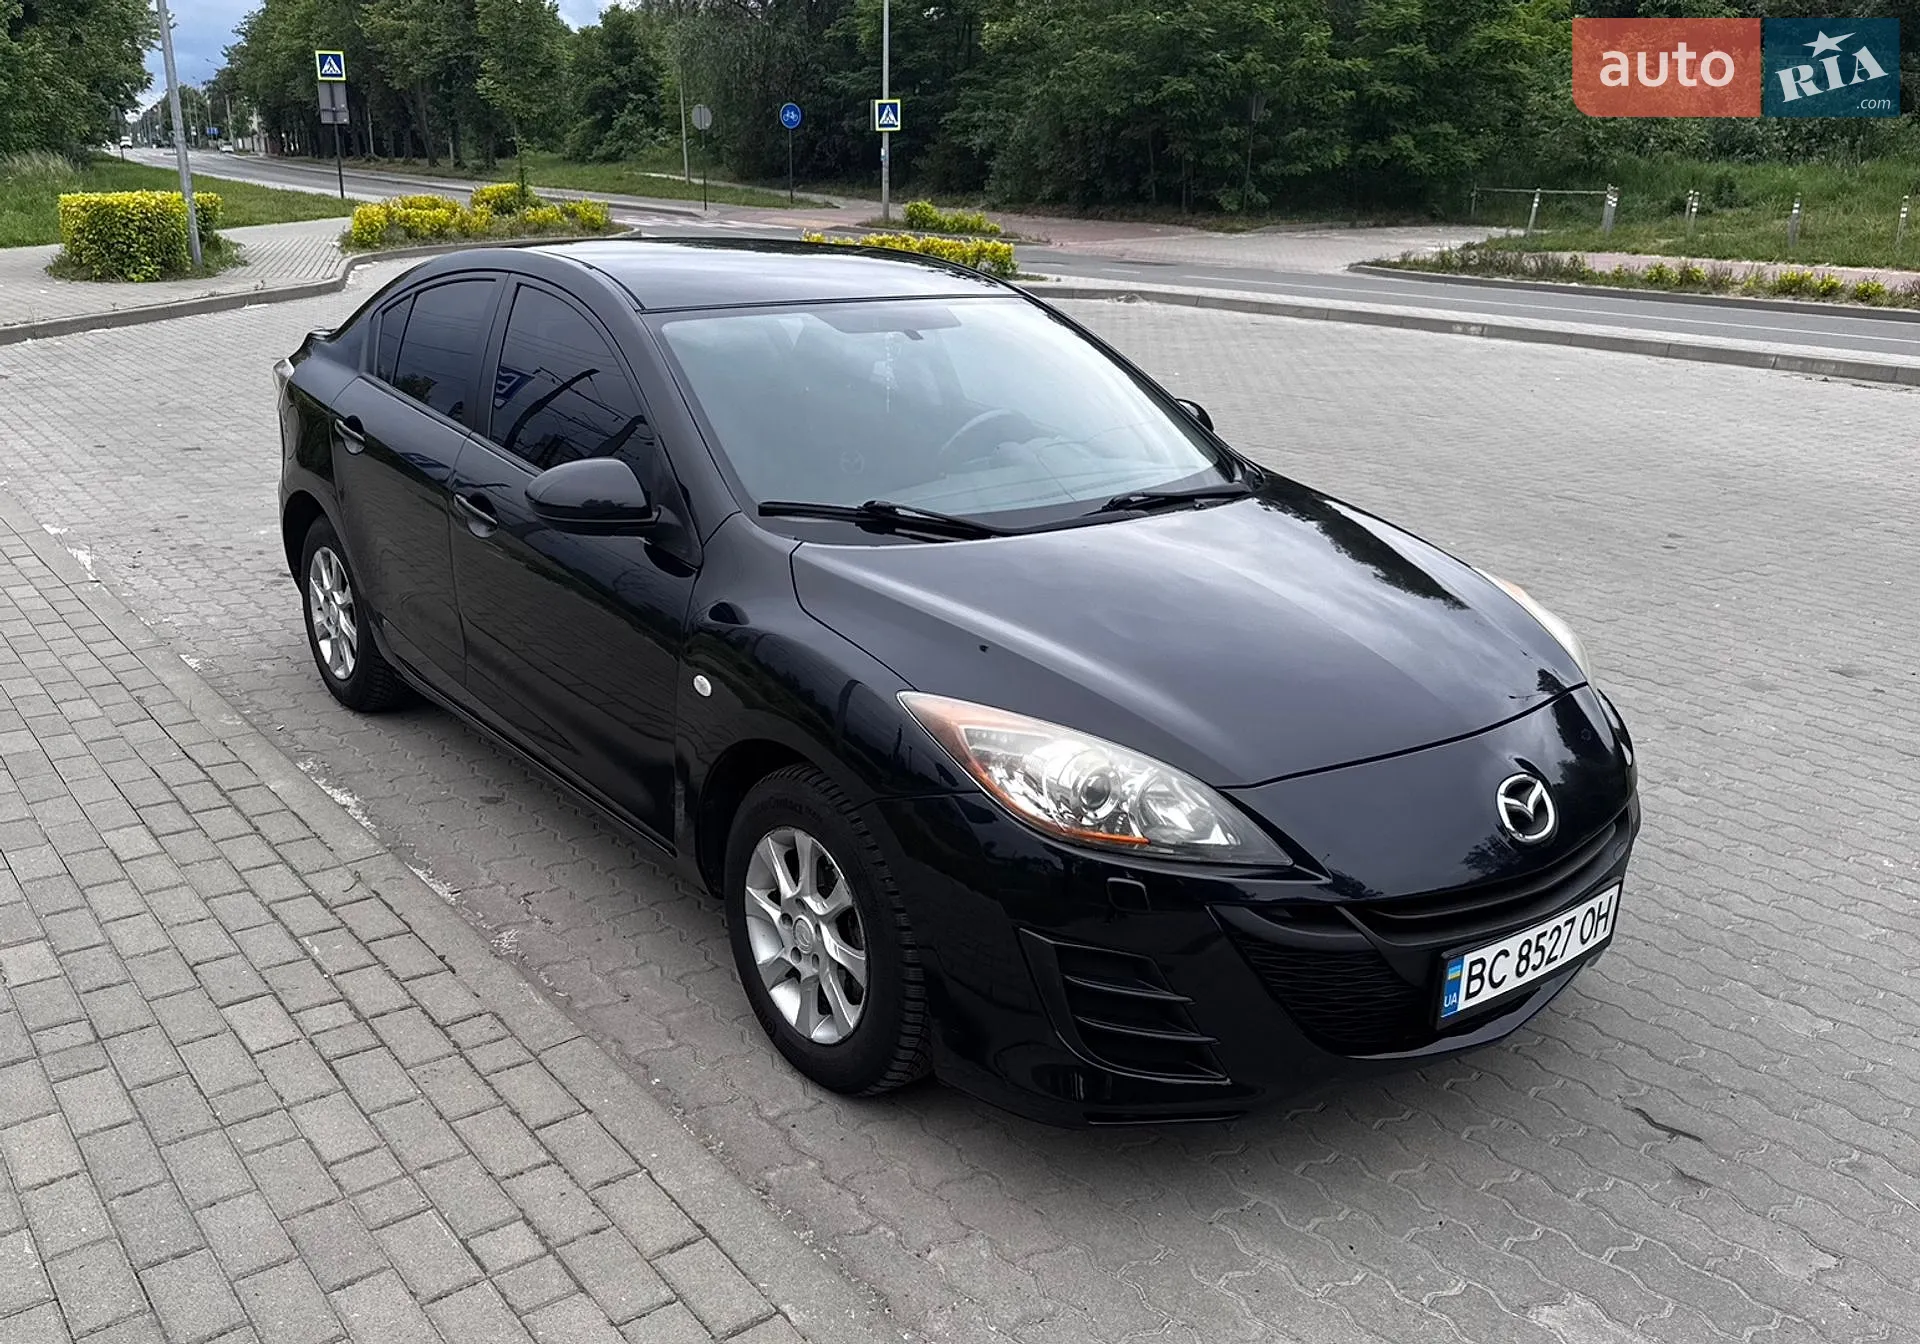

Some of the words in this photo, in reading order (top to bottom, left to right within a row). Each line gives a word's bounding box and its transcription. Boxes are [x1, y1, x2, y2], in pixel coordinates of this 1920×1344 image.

[1464, 949, 1510, 1001] BC
[1515, 916, 1577, 978] 8527
[1579, 894, 1614, 946] OH
[1444, 992, 1458, 1007] UA
